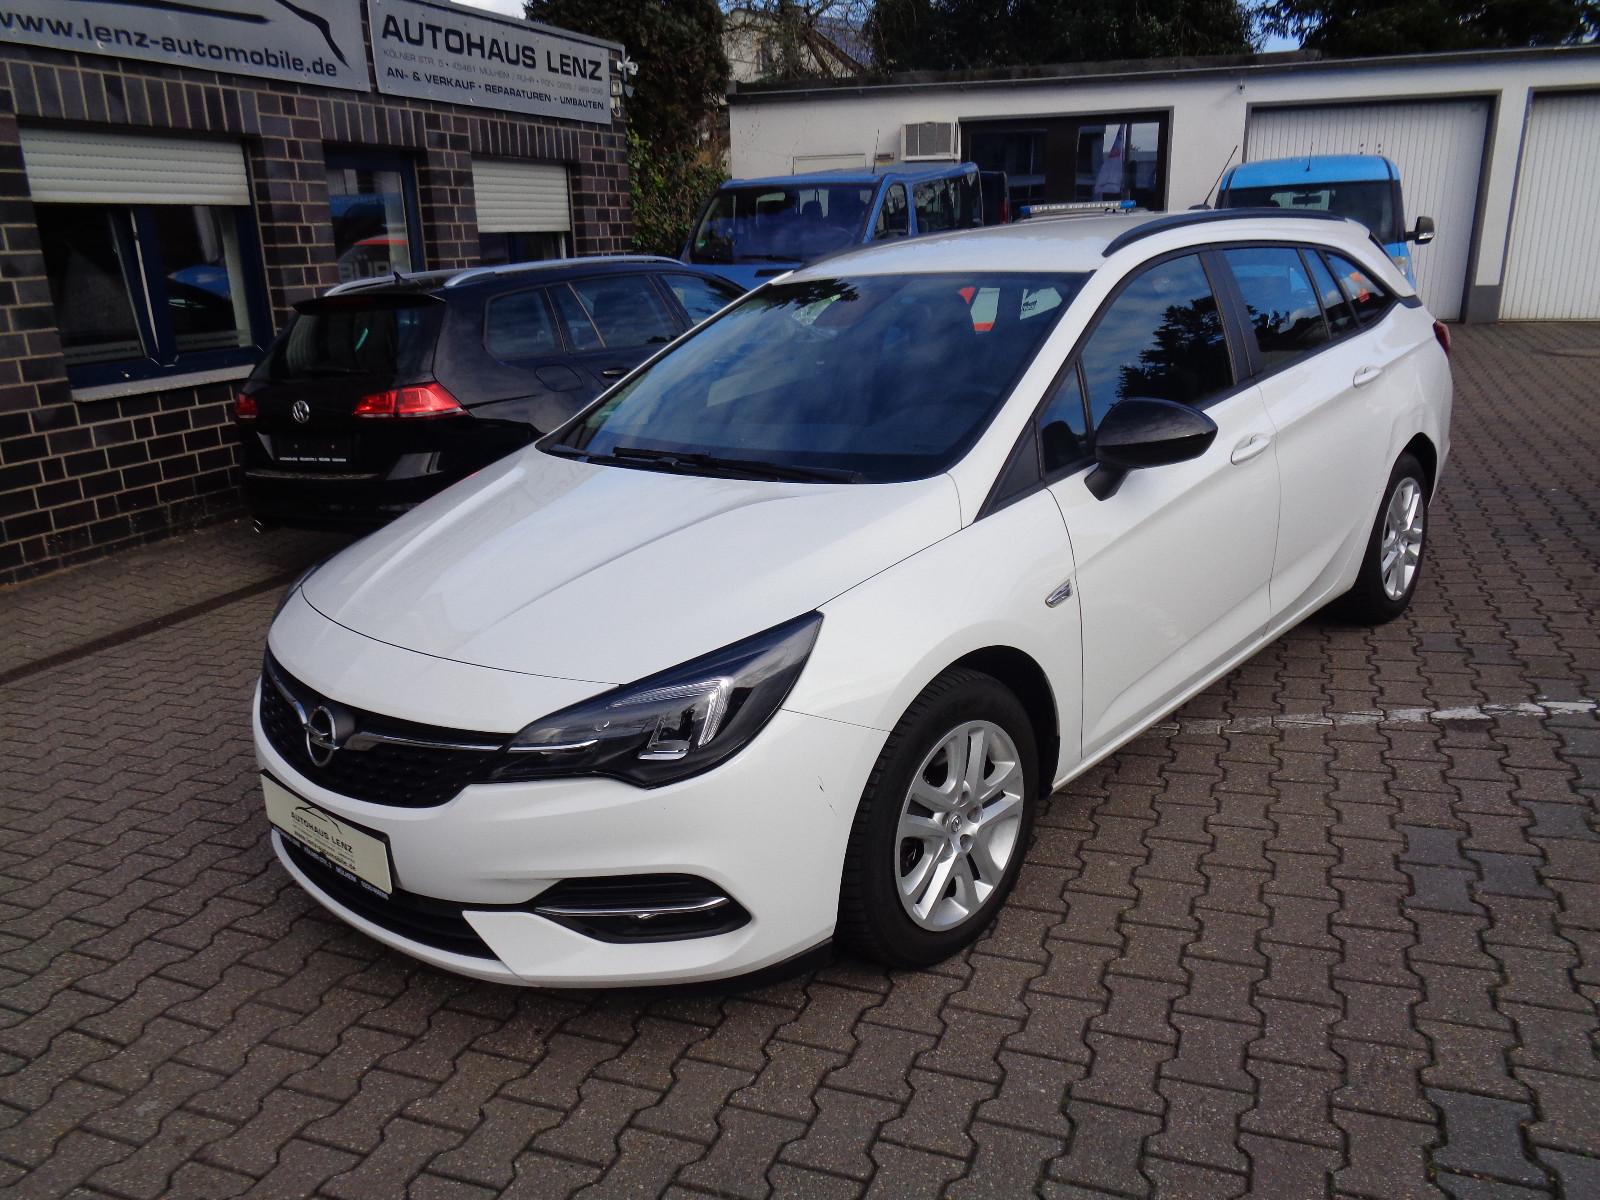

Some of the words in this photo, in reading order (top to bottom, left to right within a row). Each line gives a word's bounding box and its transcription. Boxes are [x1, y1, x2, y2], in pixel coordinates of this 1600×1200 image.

[382, 14, 536, 69] AUTOHAUS
[547, 50, 603, 81] LENZ
[387, 67, 408, 80] AN-
[412, 71, 421, 81] &
[425, 73, 476, 91] VERKAUF
[485, 84, 552, 103] REPARATUREN
[560, 96, 604, 110] UMBAUTEN
[332, 835, 353, 854] LENZ
